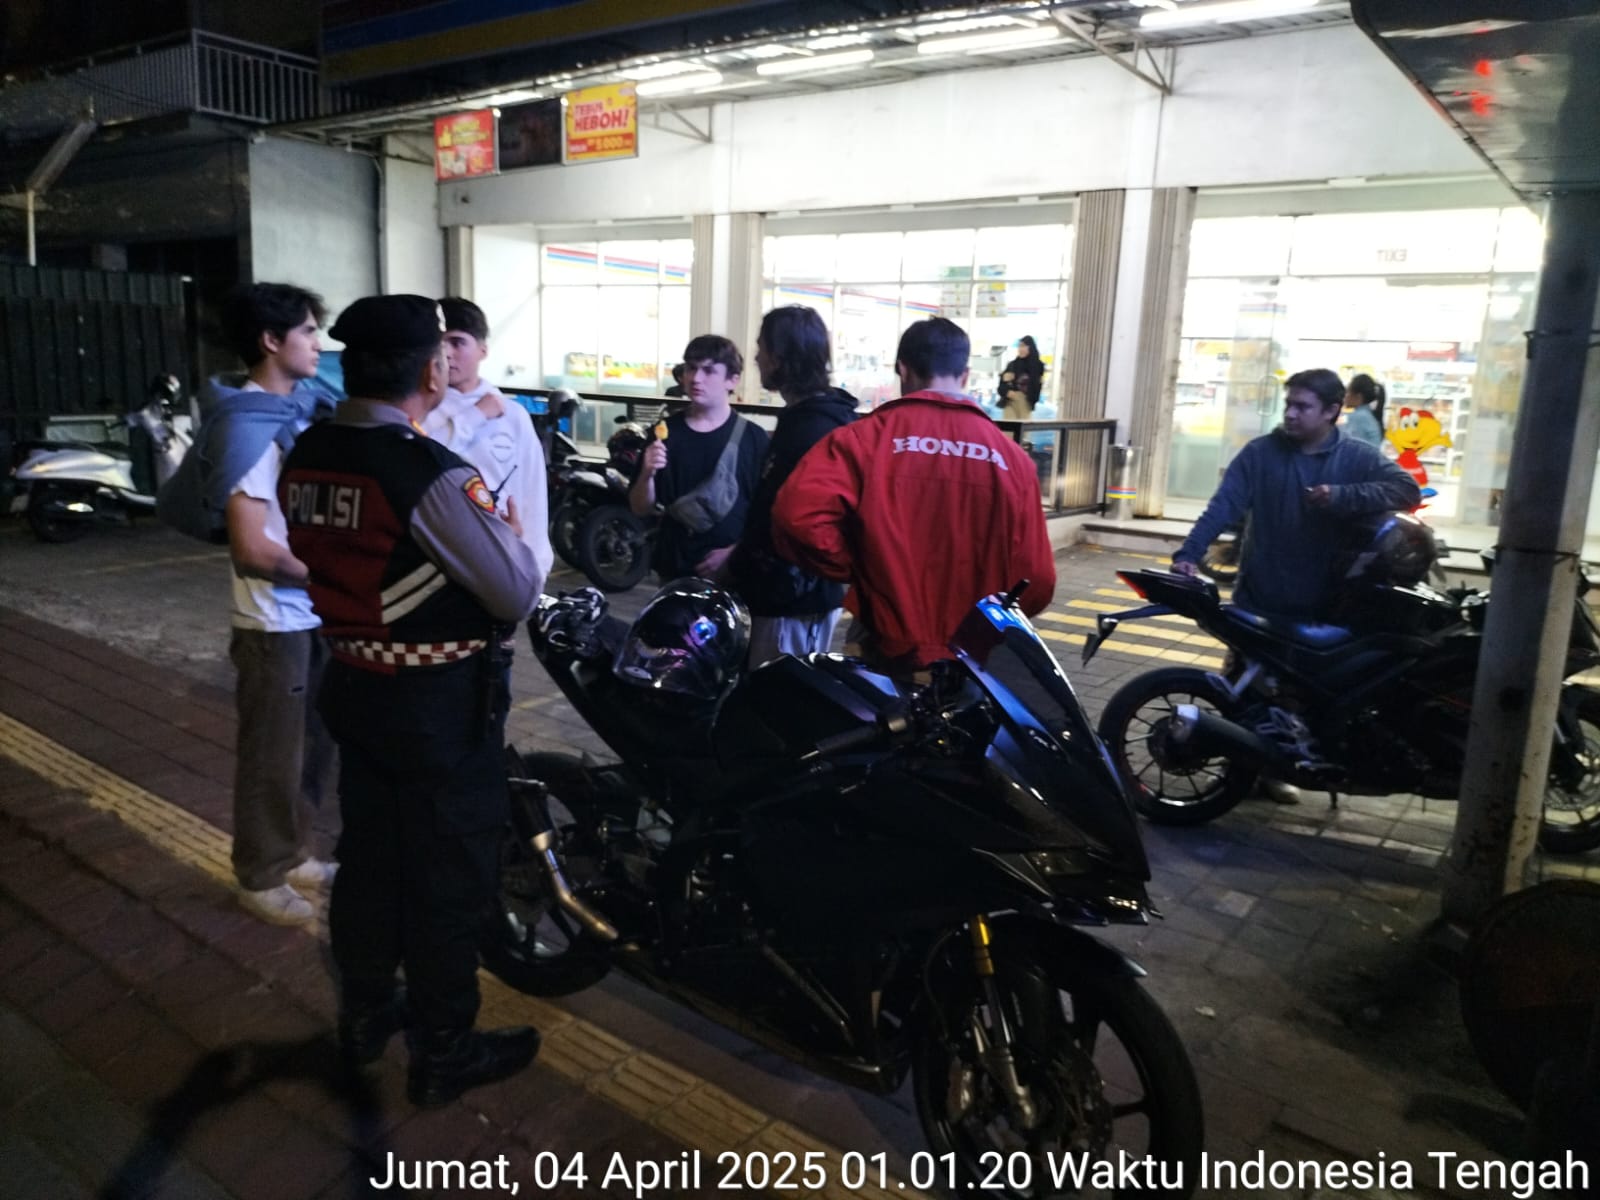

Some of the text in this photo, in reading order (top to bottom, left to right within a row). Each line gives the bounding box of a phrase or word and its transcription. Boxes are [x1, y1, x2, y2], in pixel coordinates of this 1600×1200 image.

[575, 108, 629, 131] HEBOH!
[893, 435, 1009, 471] HONDA
[286, 482, 362, 529] POLISI
